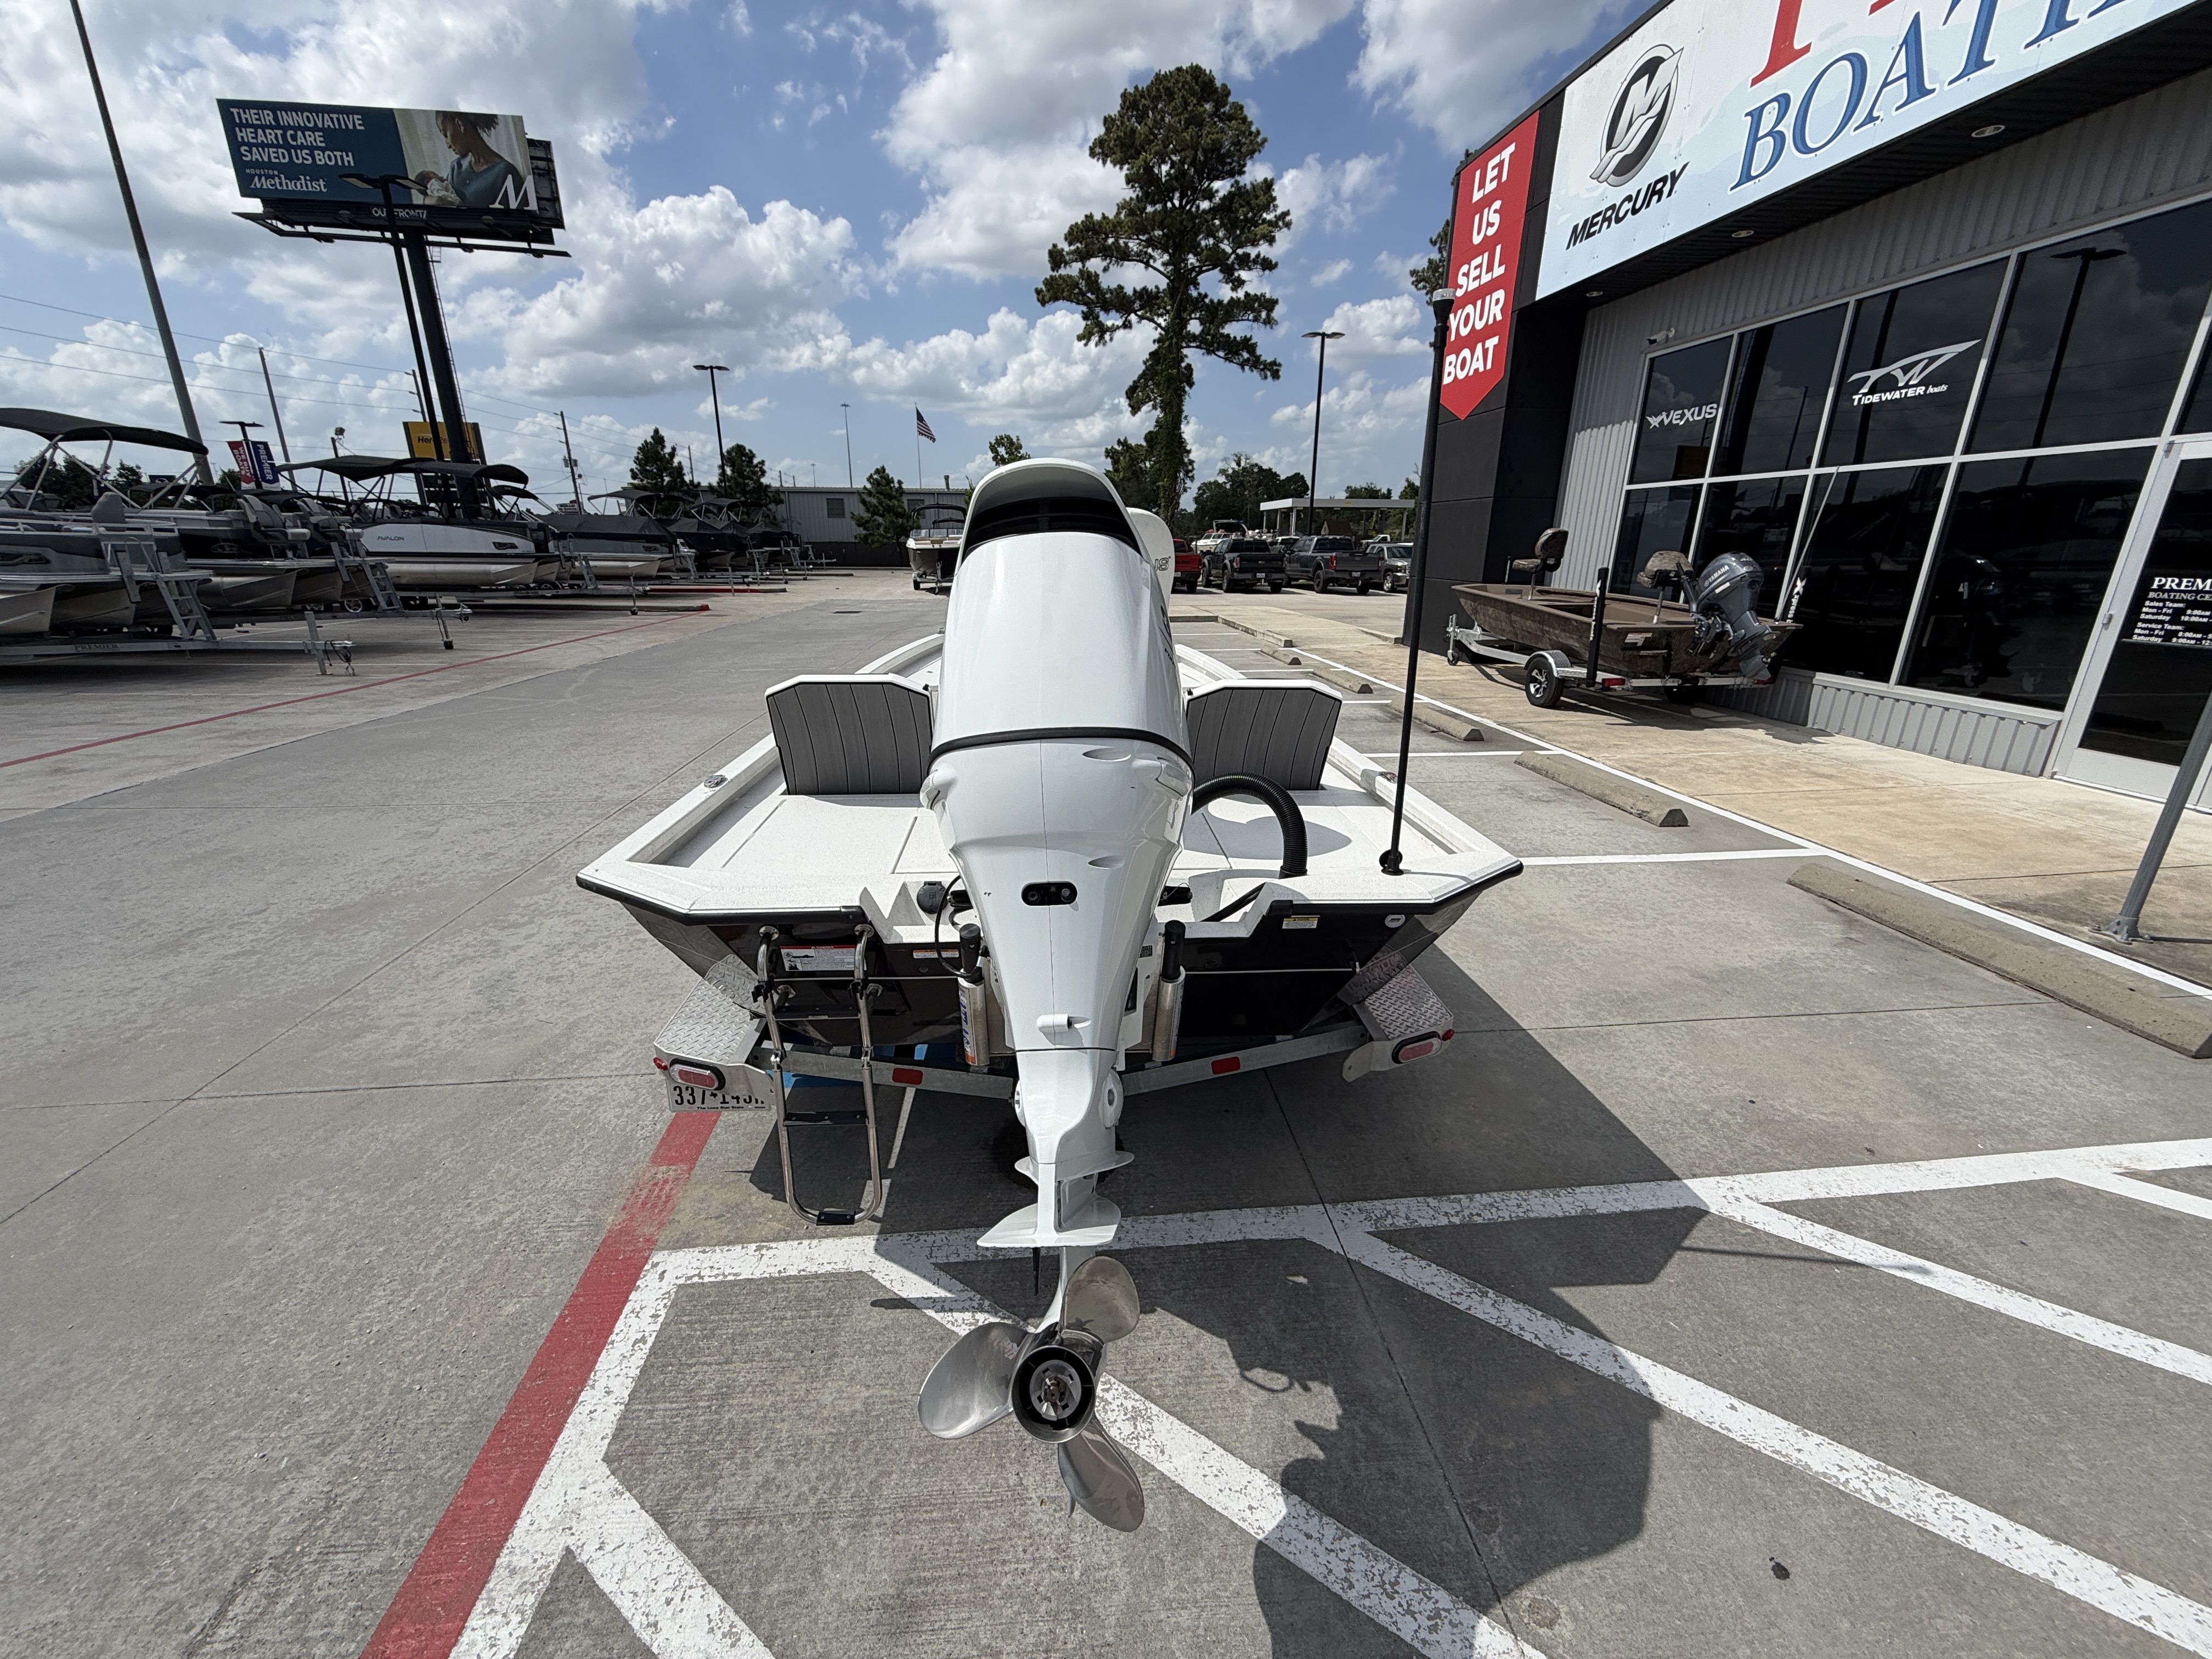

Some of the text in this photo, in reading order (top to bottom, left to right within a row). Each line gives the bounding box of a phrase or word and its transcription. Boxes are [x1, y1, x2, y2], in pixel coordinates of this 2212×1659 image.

[230, 108, 365, 130] THEIR INNOVATIVE
[235, 127, 326, 147] HEART CARE
[240, 146, 354, 166] SAVED US BOTH
[250, 174, 328, 191] Methodist
[1472, 142, 1516, 204] LET
[1566, 161, 1690, 250] MERCURY
[1472, 200, 1502, 245] US
[1455, 244, 1505, 297] SELL
[1449, 289, 1505, 342] YOUR
[1443, 335, 1499, 385] BOAT
[1927, 384, 1948, 394] boats
[1662, 403, 1718, 426] VEXUS
[257, 444, 273, 480] PREMIER
[1709, 565, 1730, 583] YAMAHA
[2147, 592, 2196, 600] BOATING
[2140, 613, 2171, 622] Saturday
[2132, 634, 2163, 643] Saturday
